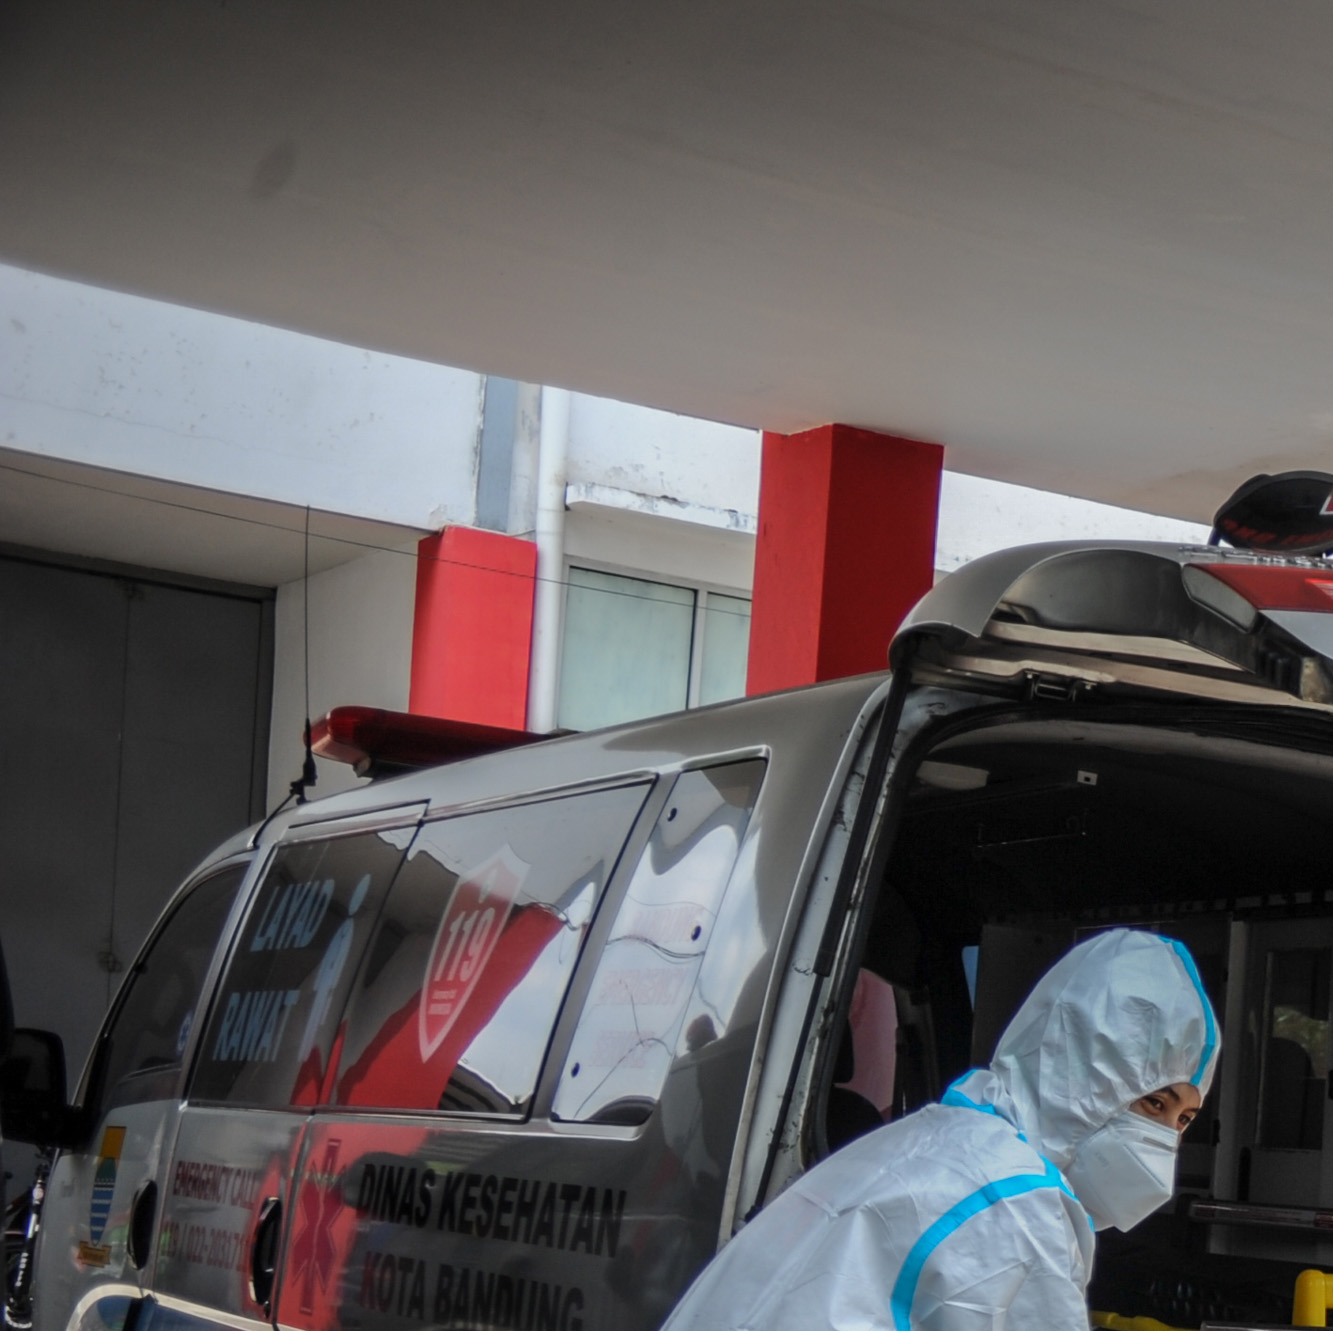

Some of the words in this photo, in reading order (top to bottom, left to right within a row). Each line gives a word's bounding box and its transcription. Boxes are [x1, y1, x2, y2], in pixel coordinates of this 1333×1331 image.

[250, 878, 336, 952] LAYAD
[433, 906, 496, 982] 119
[211, 989, 300, 1062] RAWAT
[357, 1163, 436, 1229] DINAS
[437, 1170, 628, 1259] KESEHATAN
[360, 1250, 427, 1320] KOTA
